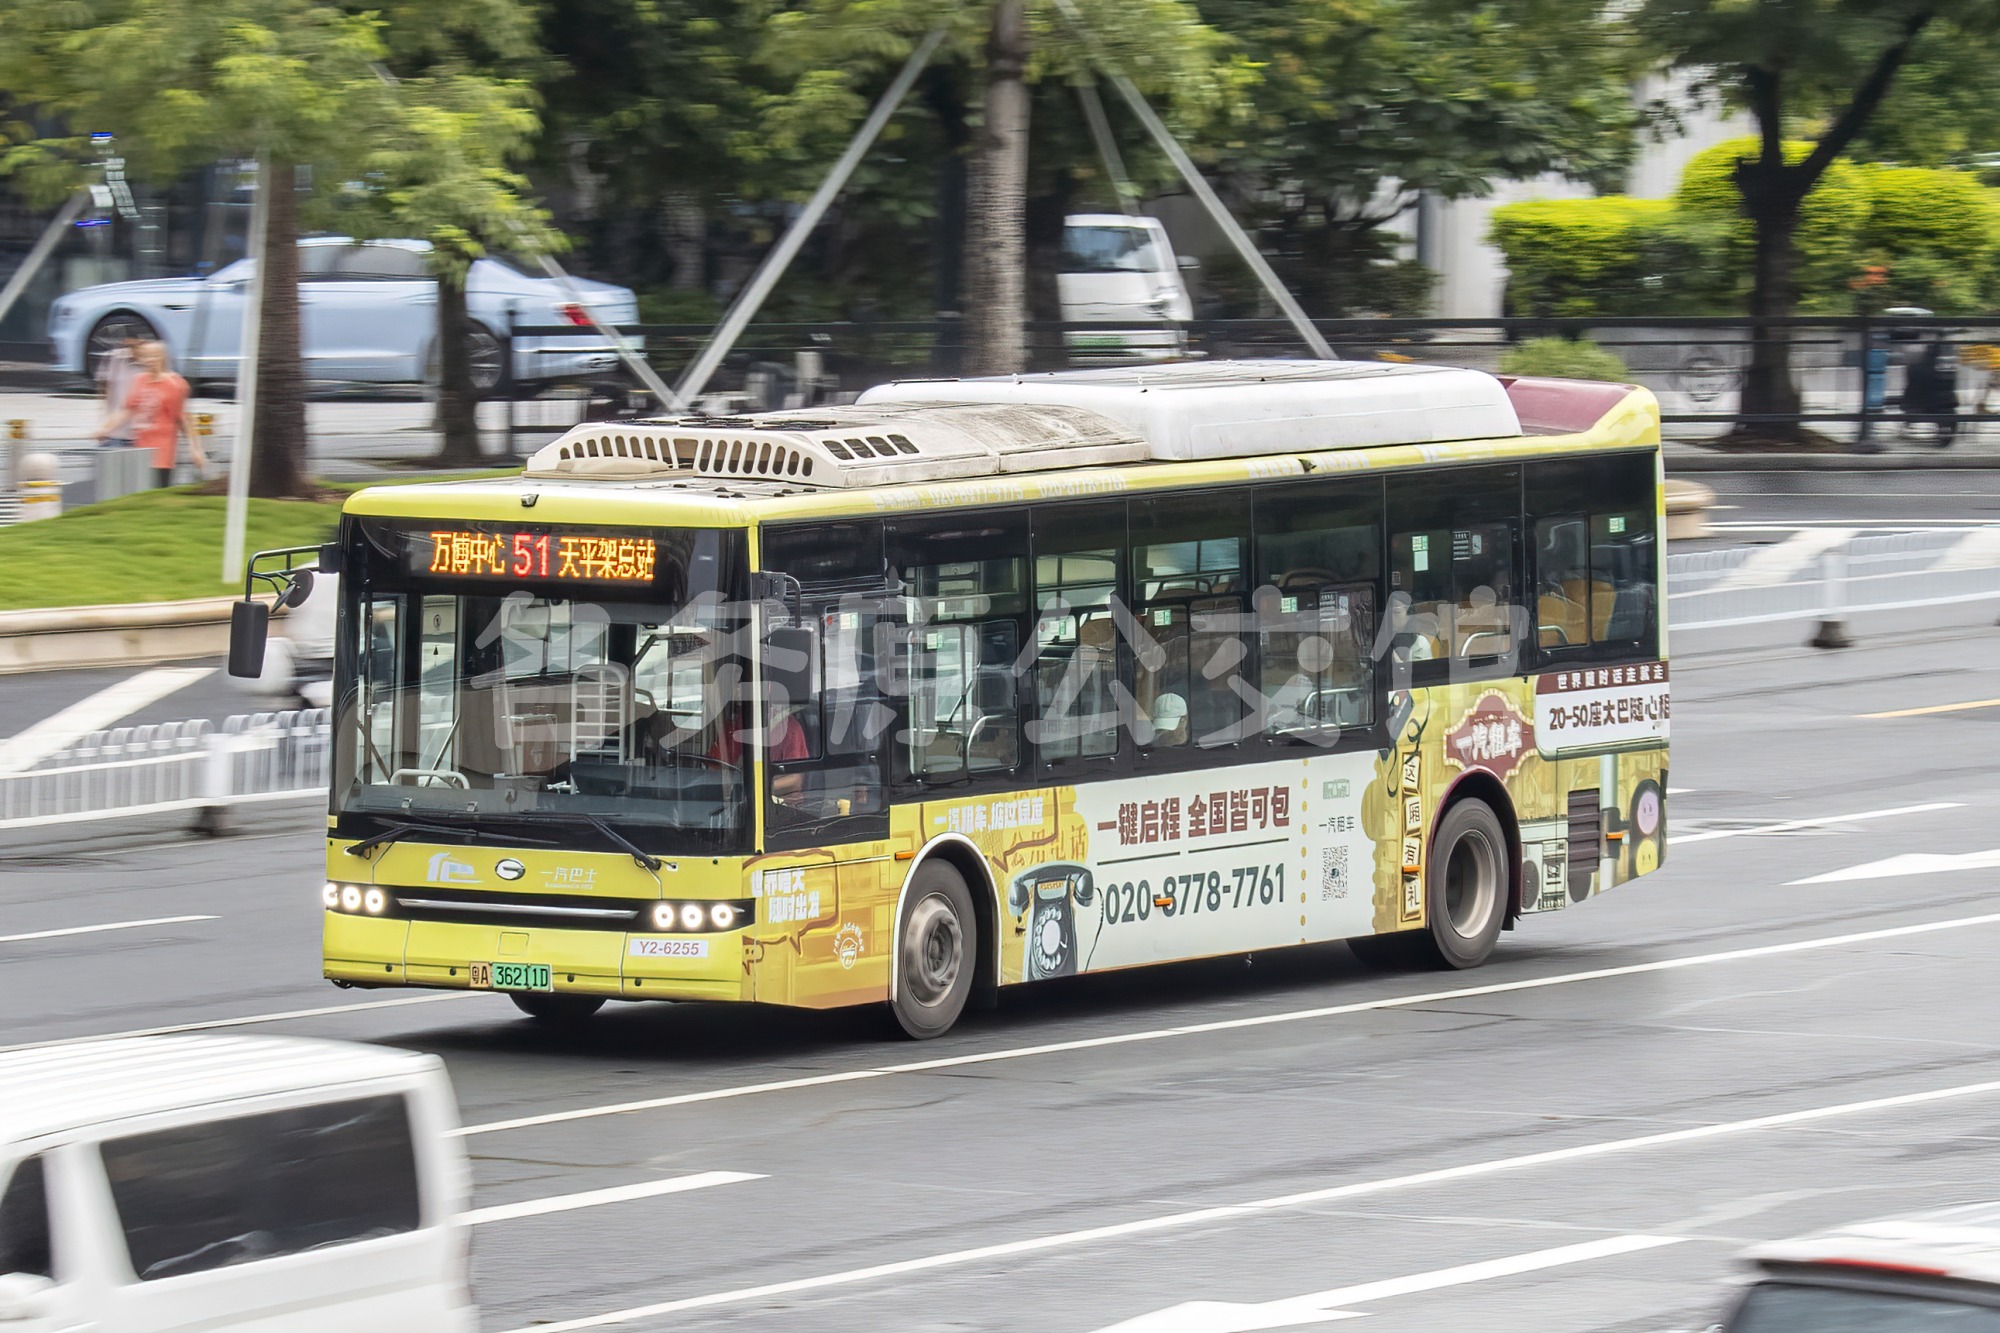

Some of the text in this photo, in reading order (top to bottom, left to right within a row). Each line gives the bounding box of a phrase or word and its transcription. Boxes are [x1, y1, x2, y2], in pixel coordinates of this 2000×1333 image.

[429, 531, 656, 580] 万博中心 51 天平架总站
[1456, 719, 1523, 761] 一汽租车
[1097, 797, 1181, 846] 一键启程
[1187, 785, 1290, 838] 全国皆可包
[1318, 815, 1355, 834] 一汽租车
[540, 866, 597, 882] 一汽巴士
[1104, 863, 1285, 925] 020-8778-7761
[639, 940, 700, 956] Y2-6255
[495, 966, 549, 987] 36211D
